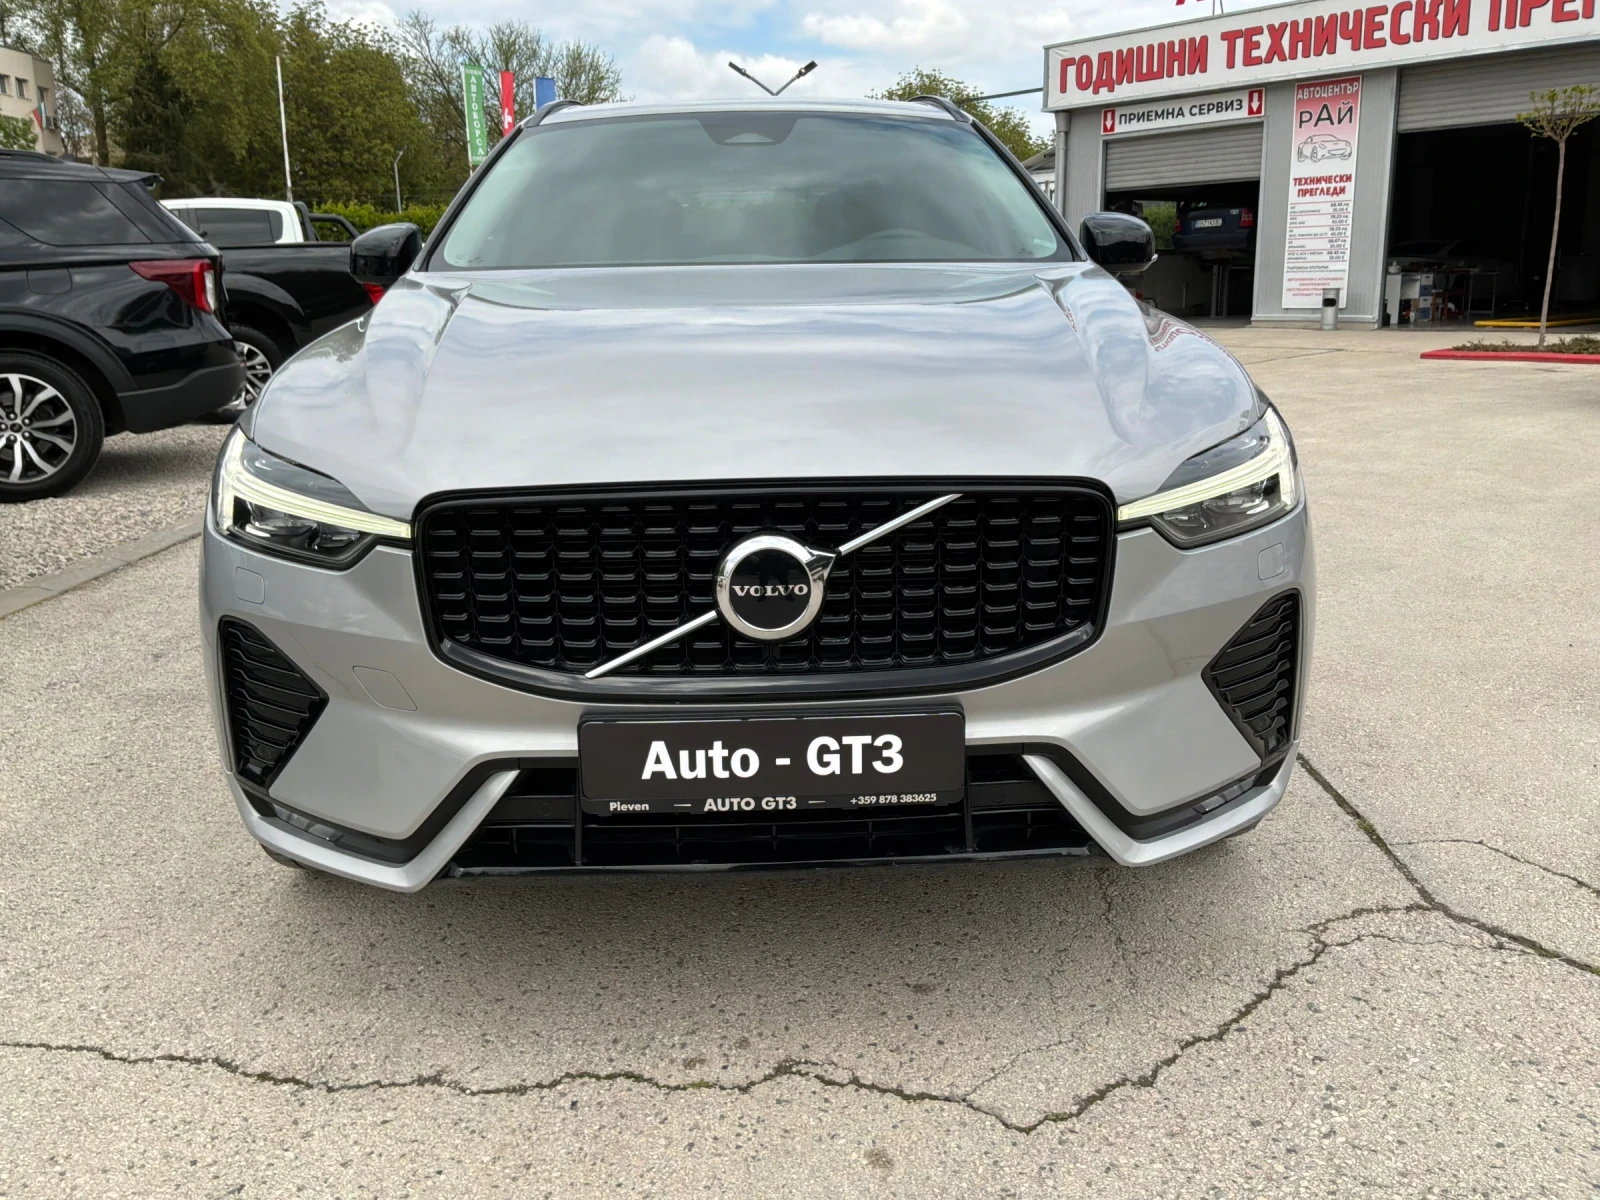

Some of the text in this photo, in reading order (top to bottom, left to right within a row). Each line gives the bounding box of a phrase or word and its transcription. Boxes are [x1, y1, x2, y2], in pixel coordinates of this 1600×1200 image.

[1059, 35, 1209, 94] ГОДИШНИ
[1220, 0, 1472, 69] ТЕХНИЧЕСКИ
[1297, 82, 1359, 100] АВТОЦЕНТЪР
[470, 75, 484, 155] АВТОБОРСА
[1119, 98, 1244, 125] ПРИЕМНА СЕРВИЗ
[1299, 100, 1354, 129] РАЙ
[1293, 173, 1353, 186] ТЕХНИЧЕСКИ
[1297, 186, 1347, 197] ПРЕГЛЕДИ
[731, 583, 809, 597] VOLVO
[641, 740, 760, 780] Auto
[806, 733, 904, 776] GT3
[609, 801, 650, 813] Pleven
[703, 796, 797, 813] AUTO GT3
[849, 792, 937, 805] +359 878 383625
